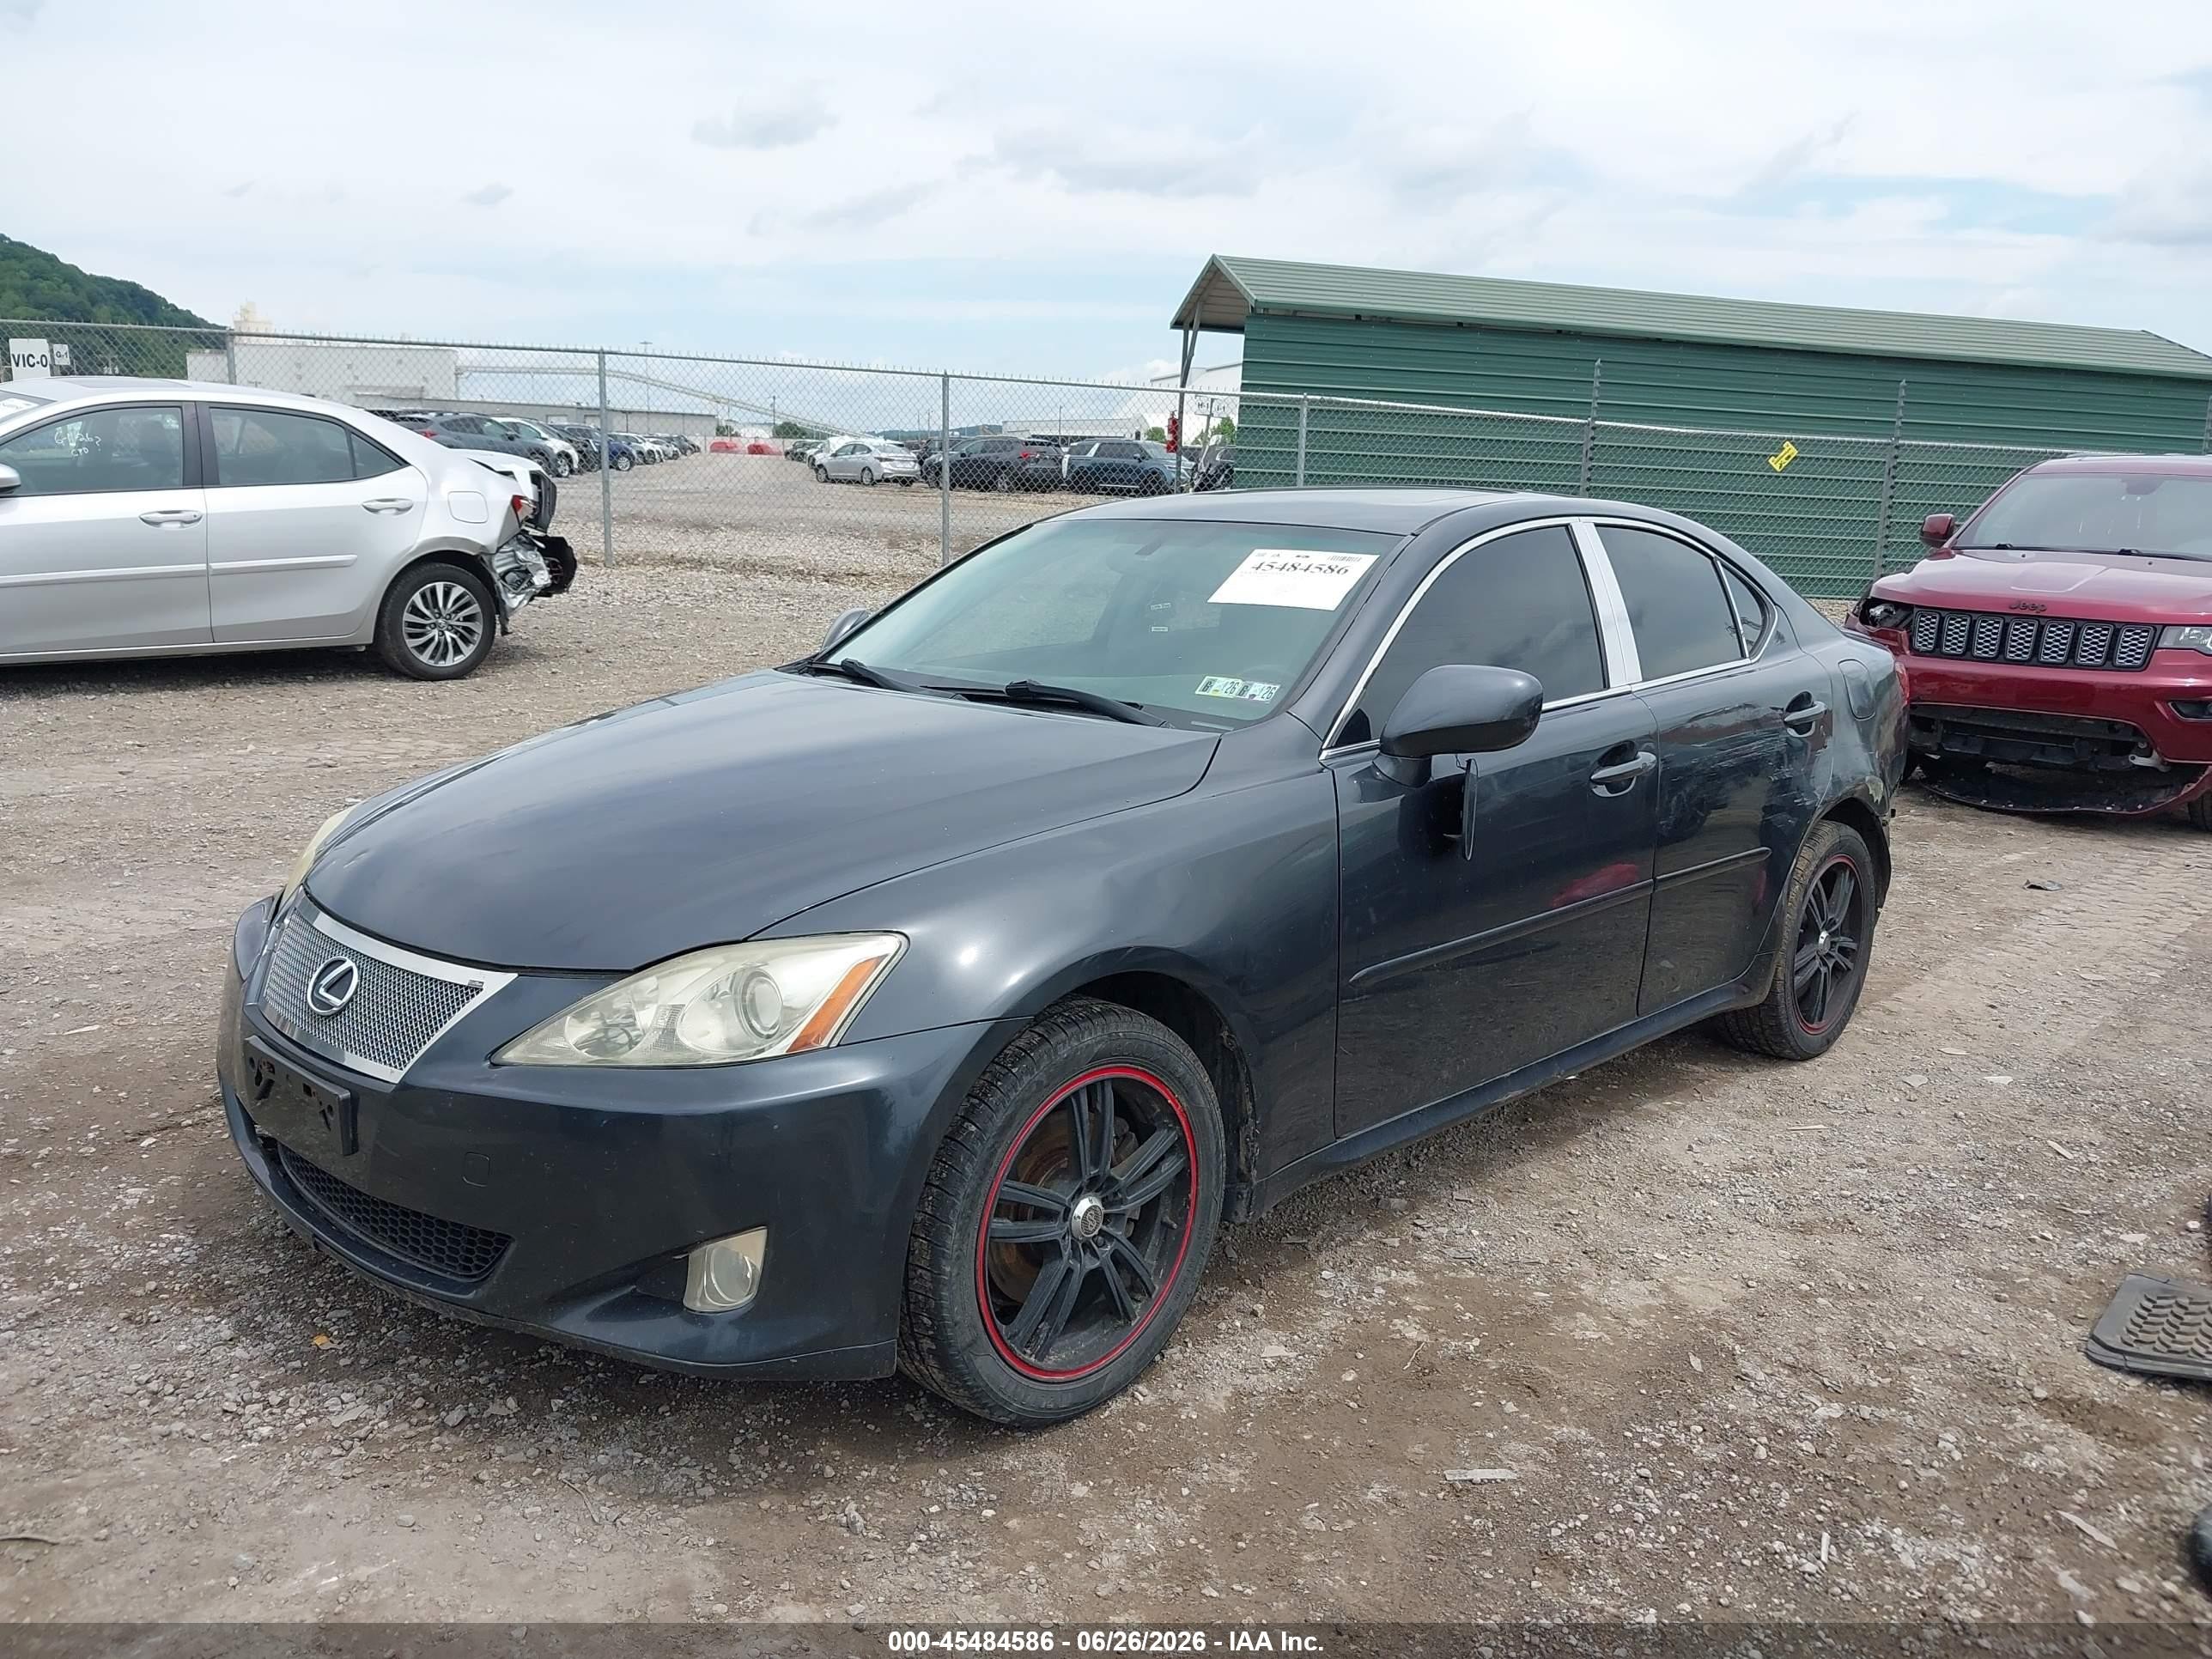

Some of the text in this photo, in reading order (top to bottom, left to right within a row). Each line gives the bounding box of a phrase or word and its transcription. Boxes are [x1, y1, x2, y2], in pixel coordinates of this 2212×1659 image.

[1251, 561, 1352, 575] 45484586
[2008, 600, 2048, 614] Jeep
[1224, 681, 1240, 695] 26
[1261, 686, 1277, 700] 26
